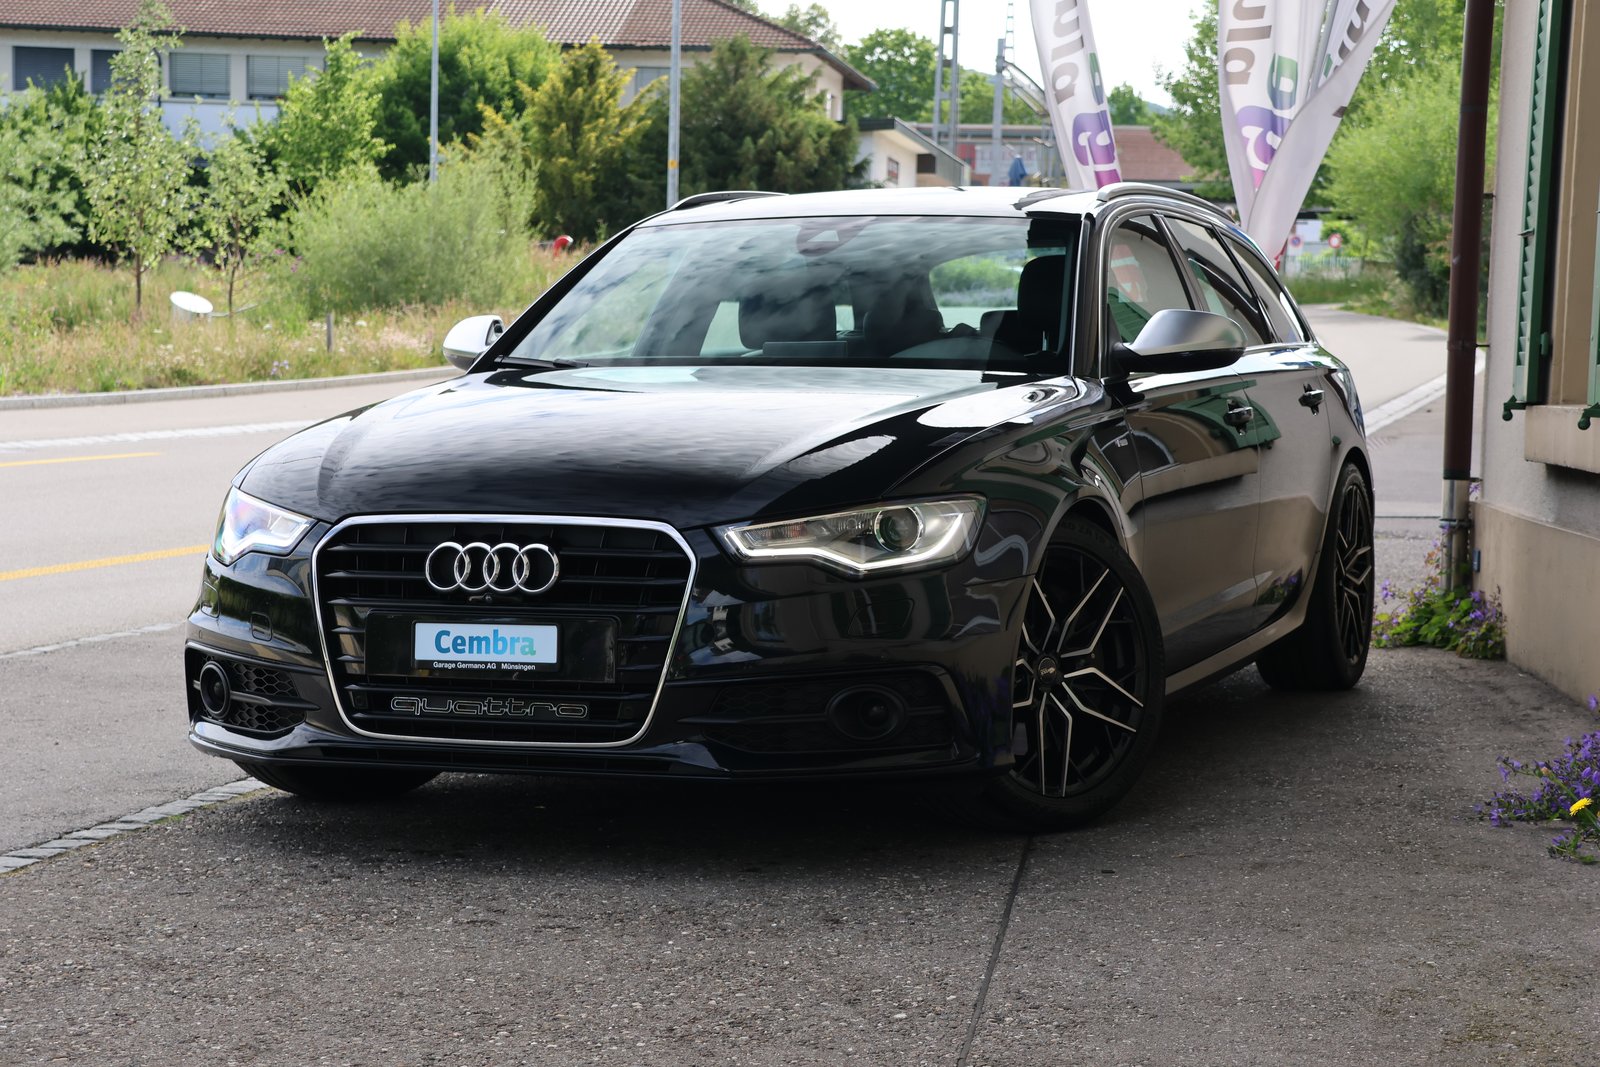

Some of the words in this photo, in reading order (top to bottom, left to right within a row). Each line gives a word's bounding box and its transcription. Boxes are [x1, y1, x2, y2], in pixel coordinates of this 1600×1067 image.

[434, 628, 537, 656] Cembra
[433, 661, 456, 670] Garage
[457, 662, 486, 670] Germano
[501, 662, 536, 672] Münsingen
[391, 696, 588, 718] quattro
